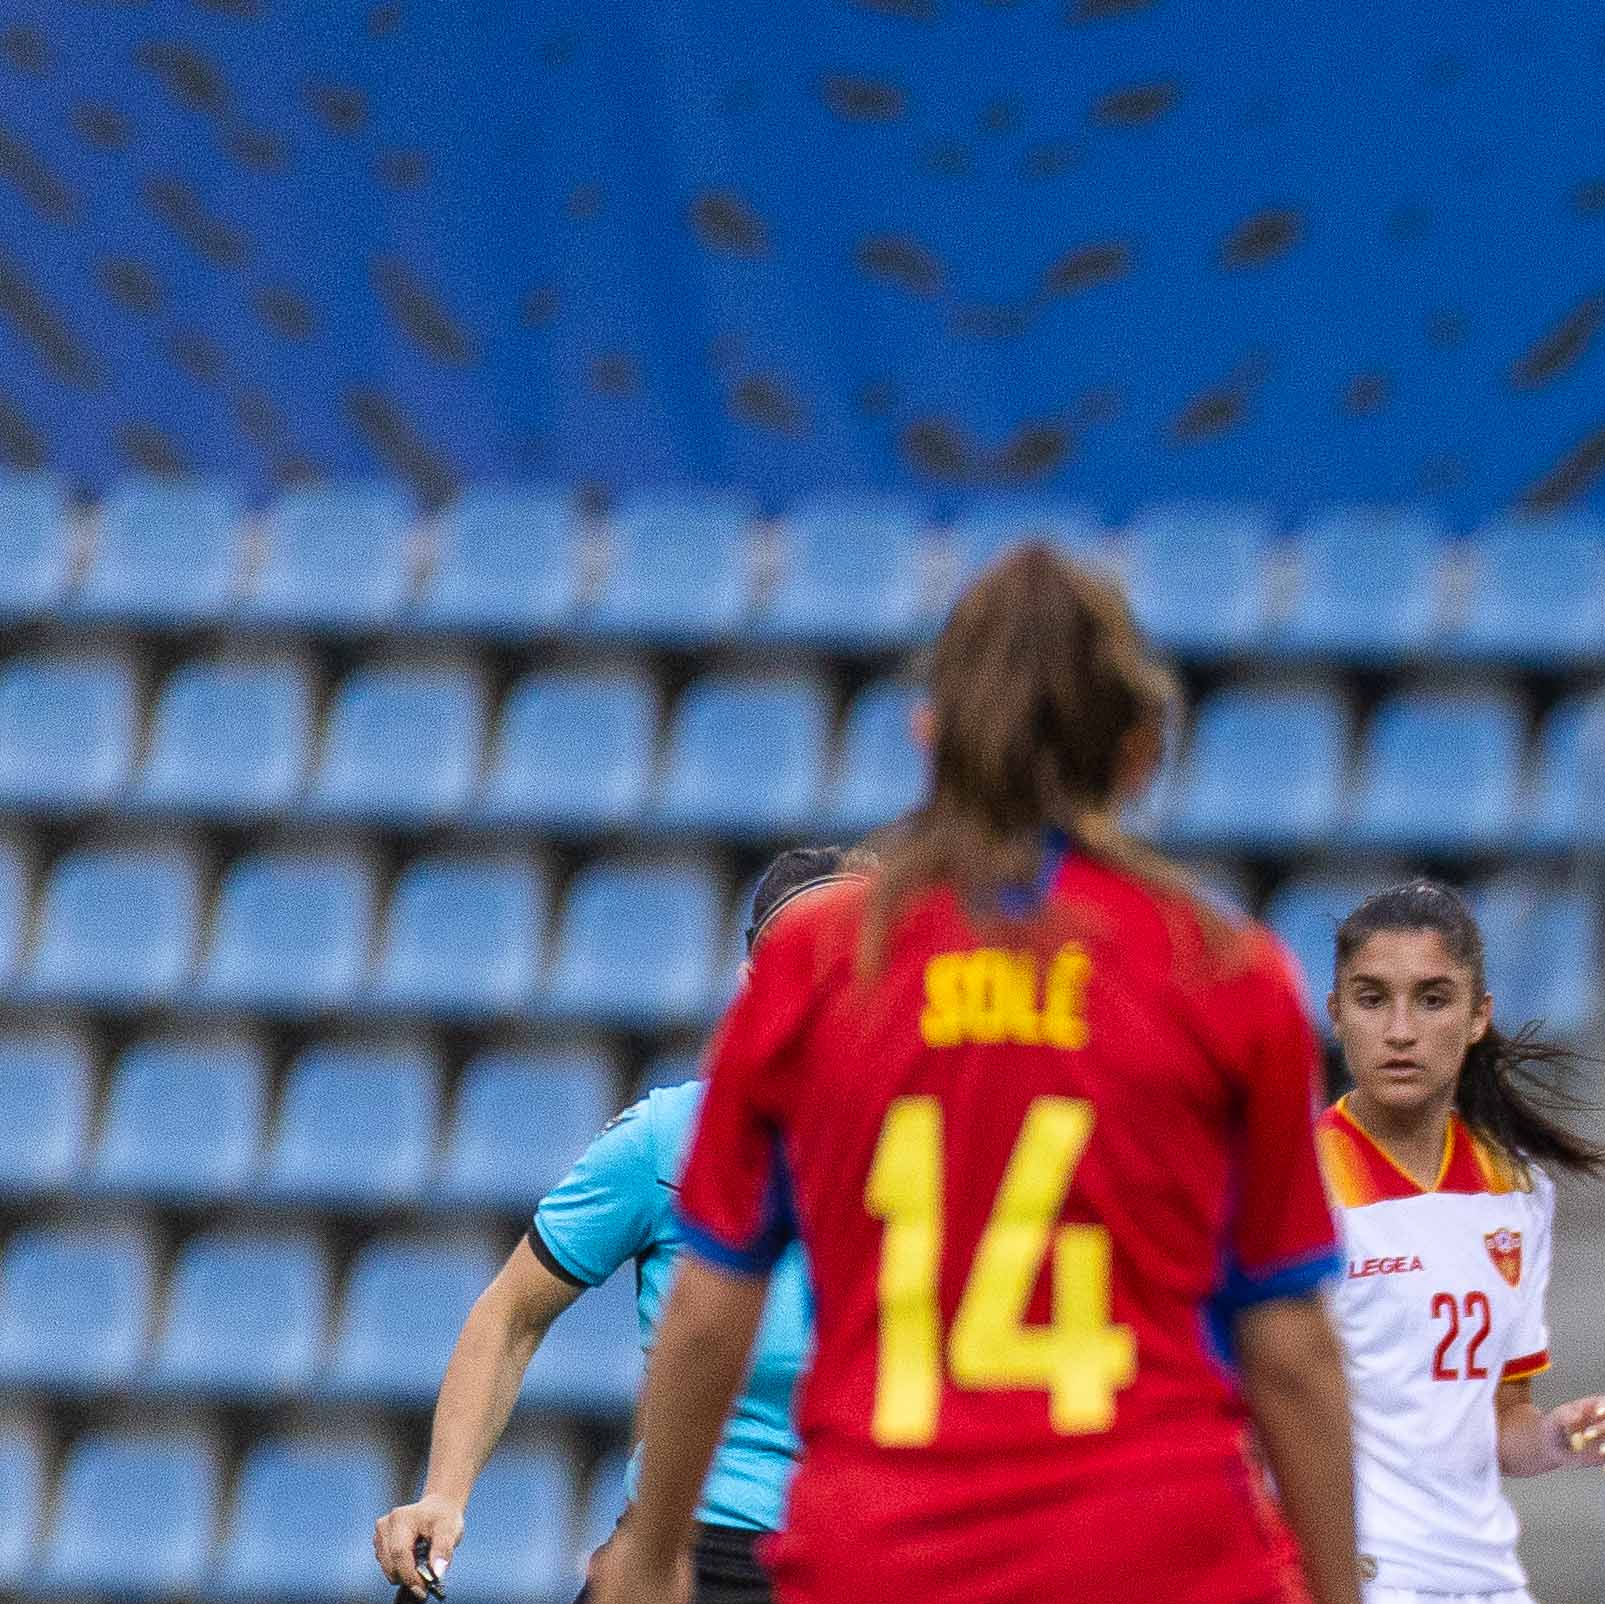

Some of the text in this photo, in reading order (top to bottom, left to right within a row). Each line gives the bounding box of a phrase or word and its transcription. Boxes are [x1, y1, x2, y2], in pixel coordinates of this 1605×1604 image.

[920, 940, 1096, 1050] SOLÉ
[864, 1094, 1138, 1448] 14
[1349, 1256, 1424, 1279] LEGEA
[1432, 1291, 1492, 1382] 22
